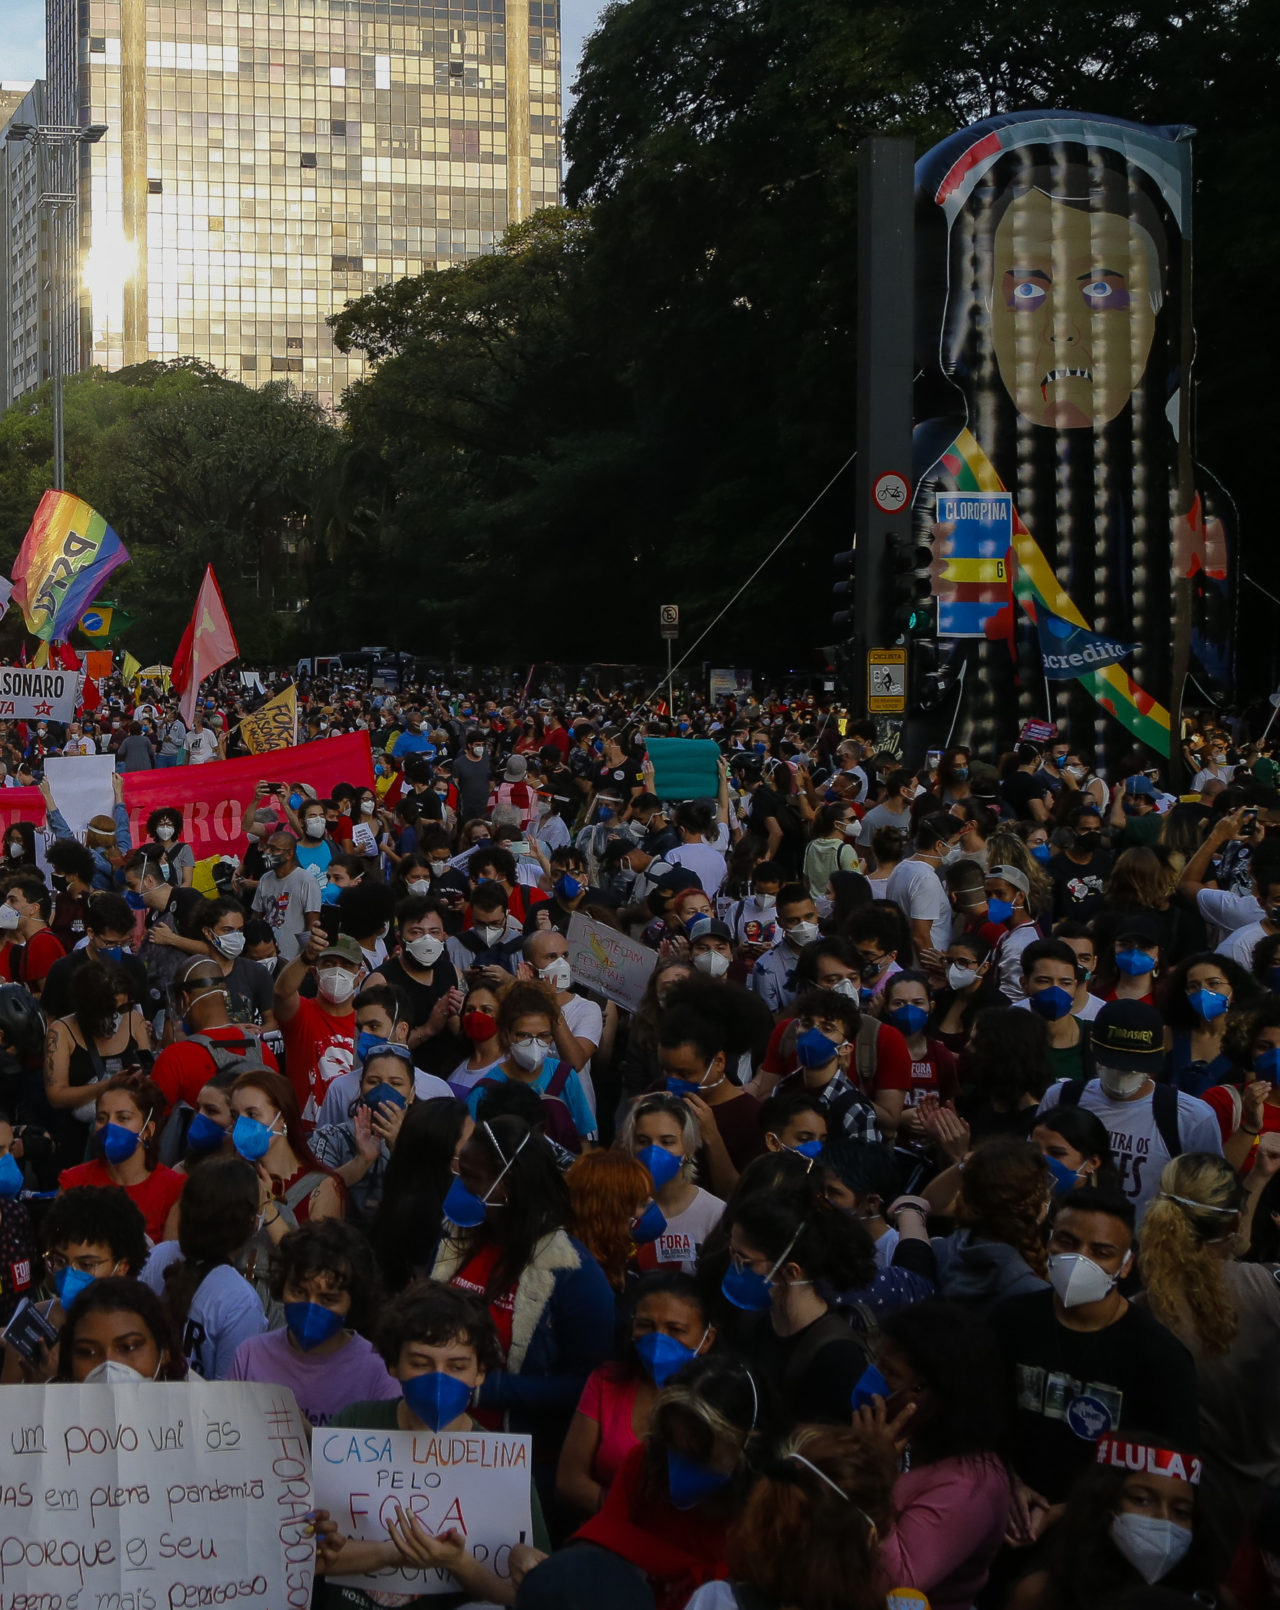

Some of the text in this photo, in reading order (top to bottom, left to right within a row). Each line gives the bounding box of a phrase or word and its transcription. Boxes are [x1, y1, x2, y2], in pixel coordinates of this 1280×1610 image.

[945, 502, 1007, 521] CLOROPINA
[996, 561, 1004, 578] G
[911, 1063, 932, 1074] FORA
[1109, 1131, 1151, 1154] NTRA OS
[660, 1234, 690, 1249] FORA
[11, 1423, 48, 1451] um
[64, 1422, 138, 1466] povo
[201, 1408, 243, 1449] às
[322, 1434, 393, 1464] CASA
[377, 1470, 442, 1489] PELO
[45, 1485, 79, 1509] em
[166, 1479, 266, 1522] pandemia
[264, 1398, 315, 1610] #FORABOLSO
[349, 1493, 468, 1536] FORA
[159, 1532, 218, 1560] seu
[97, 1588, 157, 1610] mais
